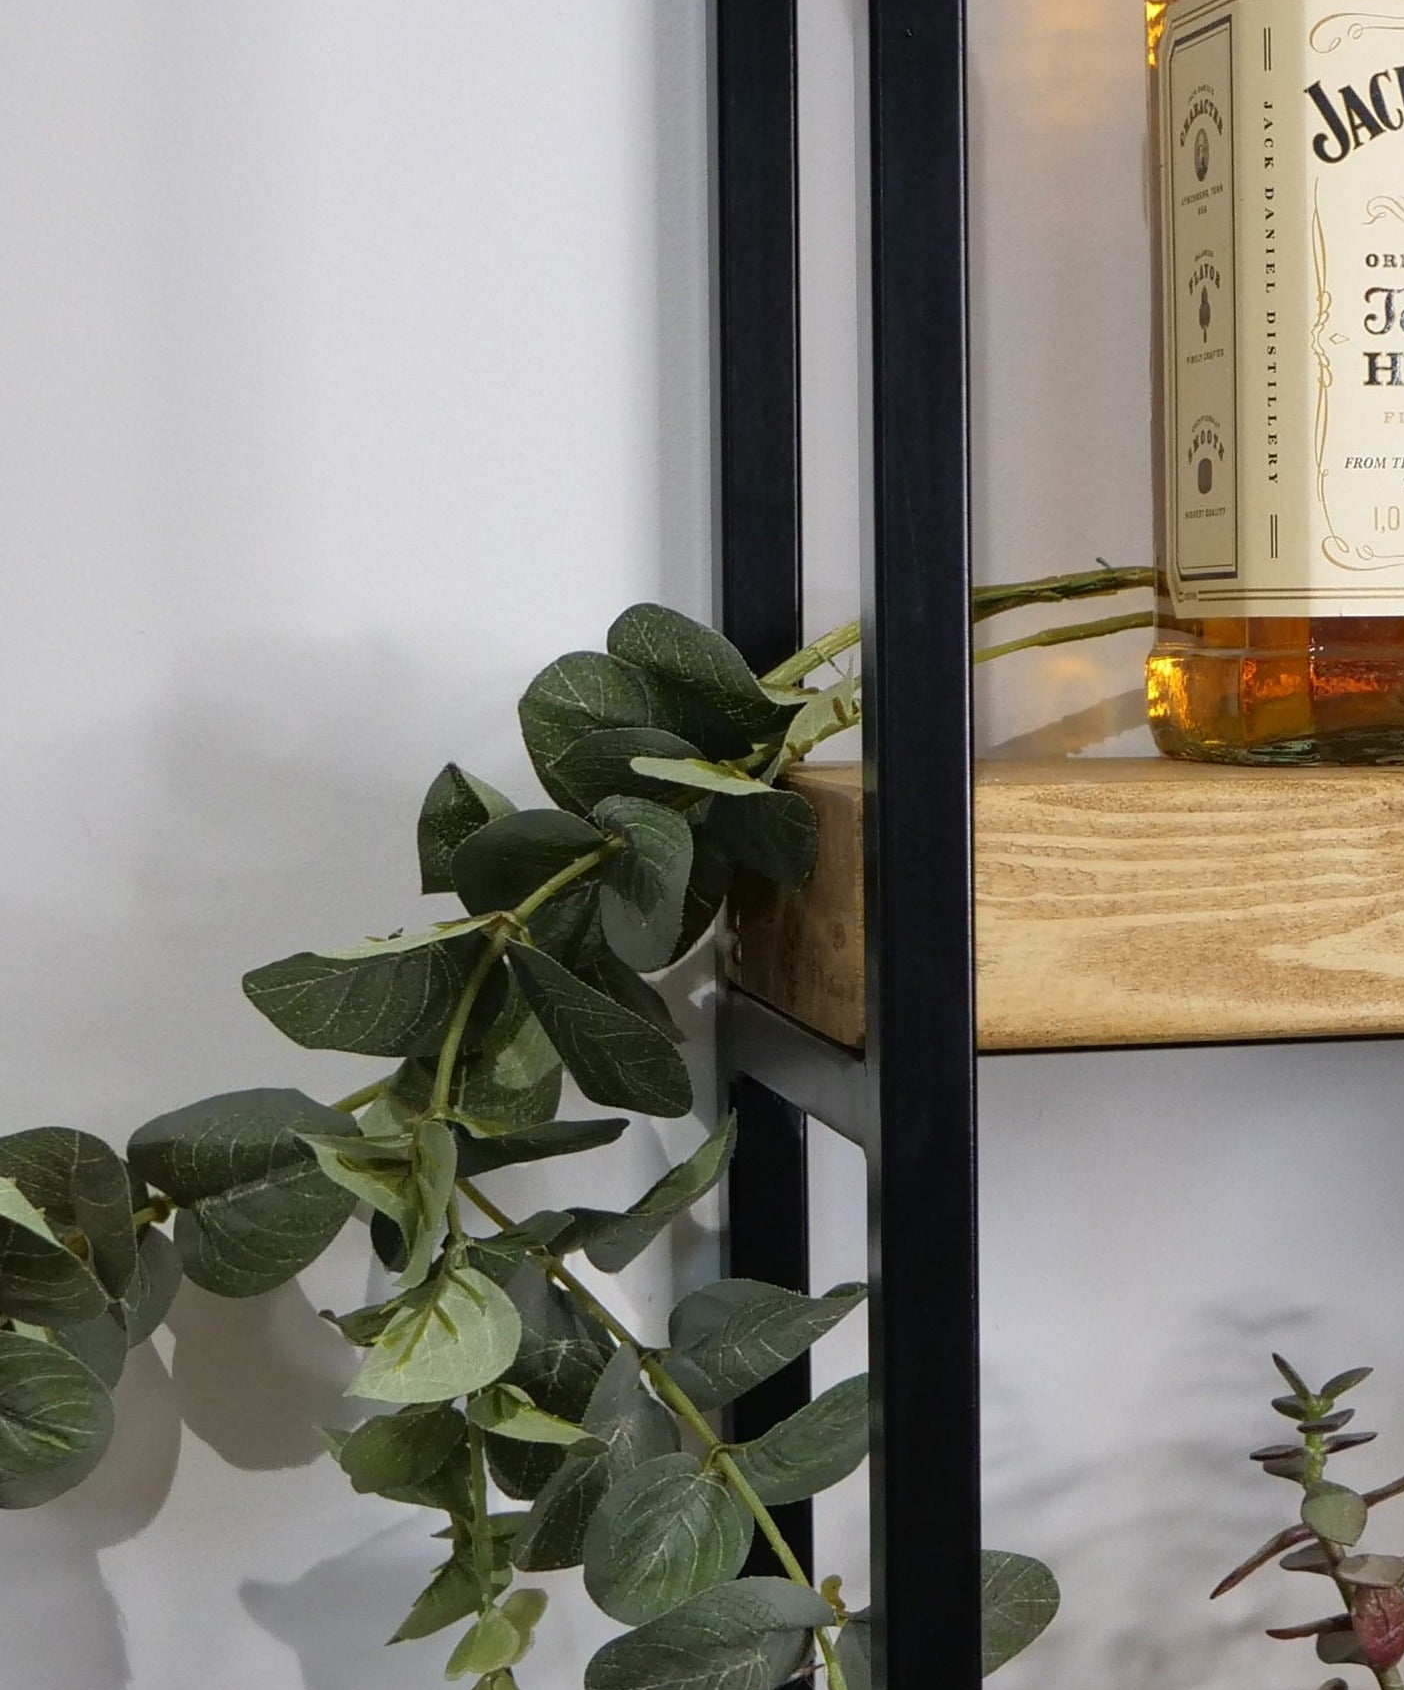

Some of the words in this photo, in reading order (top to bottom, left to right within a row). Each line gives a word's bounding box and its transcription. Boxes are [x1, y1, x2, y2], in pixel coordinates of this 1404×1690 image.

[1263, 100, 1275, 169] JACK
[1264, 187, 1276, 293] DANIEL
[1266, 311, 1279, 484] DISTILLERY
[1344, 457, 1388, 469] FROM
